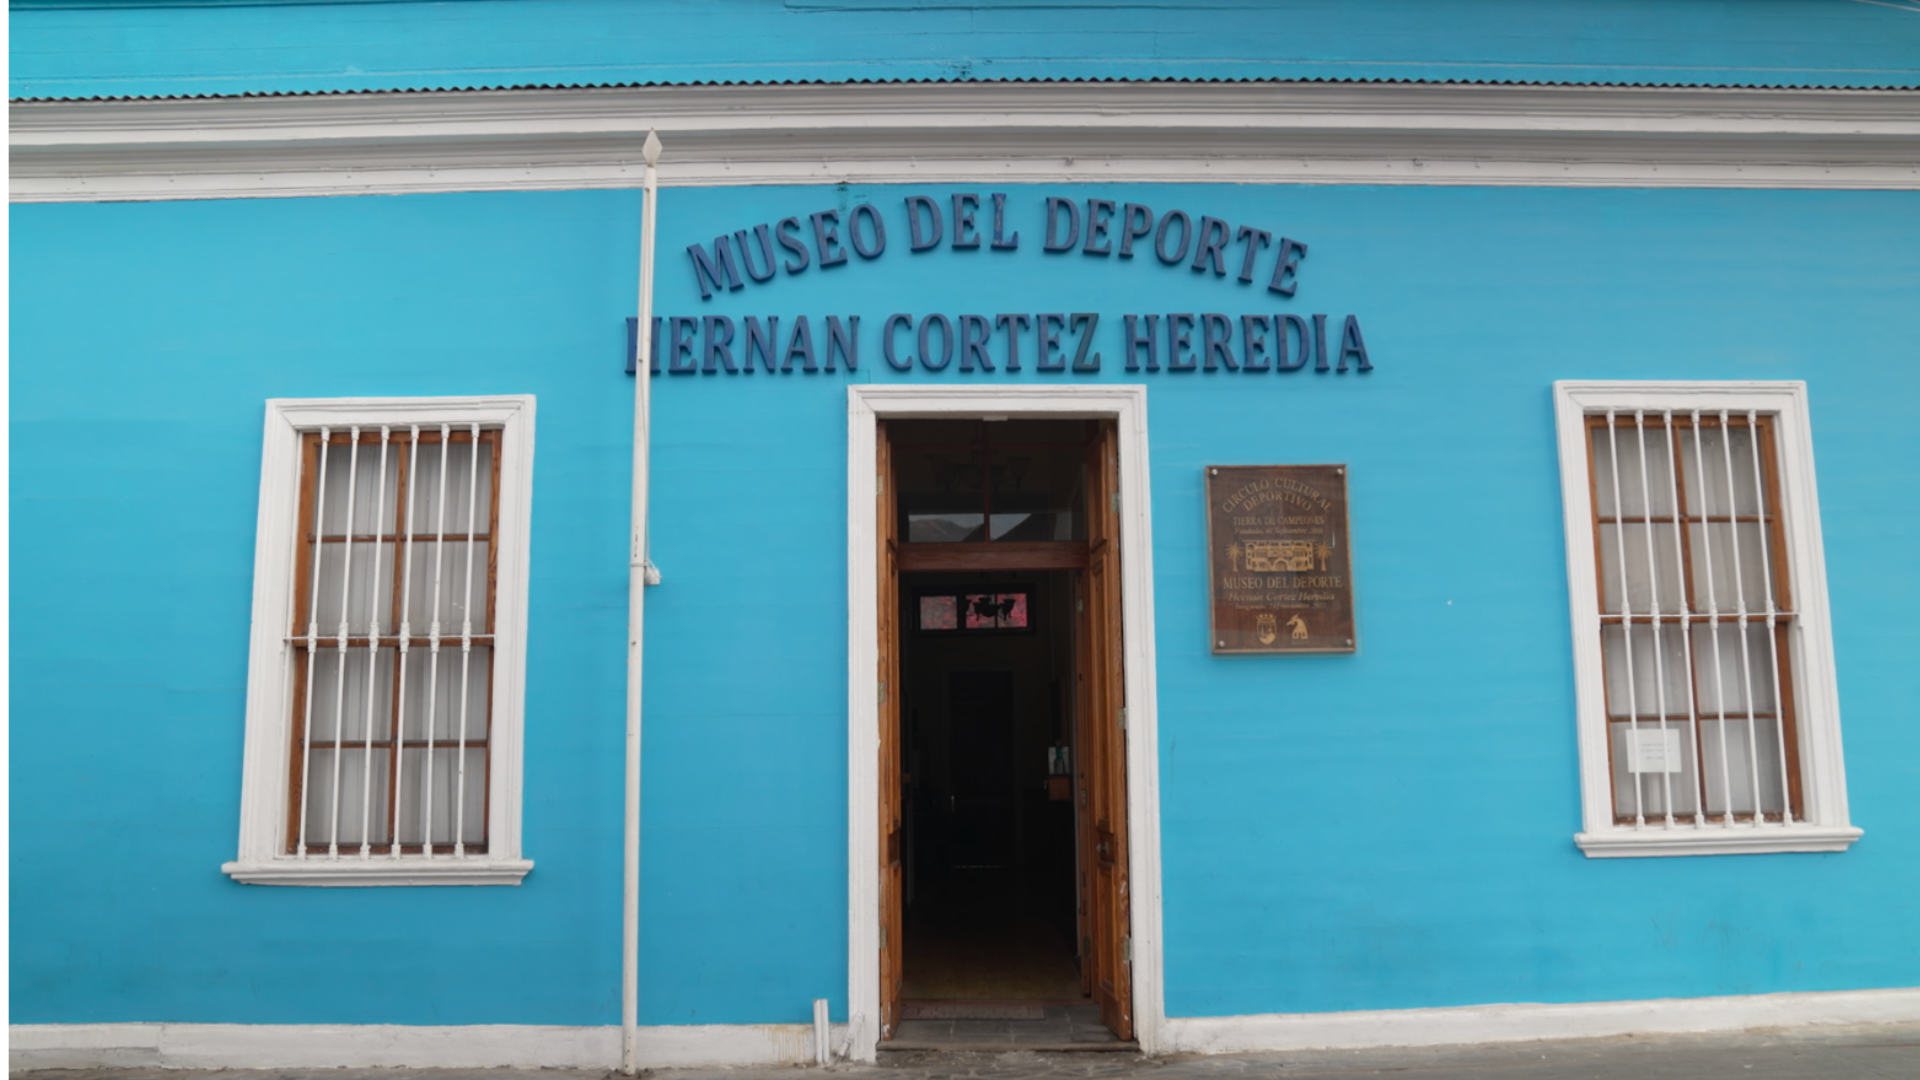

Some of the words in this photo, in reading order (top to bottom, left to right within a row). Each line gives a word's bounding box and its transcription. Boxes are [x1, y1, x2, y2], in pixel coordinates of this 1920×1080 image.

[686, 203, 887, 300] MUSEO
[904, 193, 1019, 252] DEL
[1042, 196, 1309, 297] DEPORTE
[624, 315, 861, 374] HERNAN
[882, 312, 1101, 373] CORTEZ
[1122, 313, 1375, 373] HEREDIA
[1222, 479, 1270, 513] CIRCULO
[1274, 477, 1332, 513] CULTURAL
[1242, 490, 1312, 512] DEPORTIVO
[1232, 516, 1263, 526] TIERRA
[1264, 516, 1276, 525] DE
[1277, 515, 1325, 525] CAMPEONES
[1223, 577, 1263, 589] MUSEO
[1267, 577, 1290, 589] DEL
[1293, 576, 1343, 588] DEPORTE
